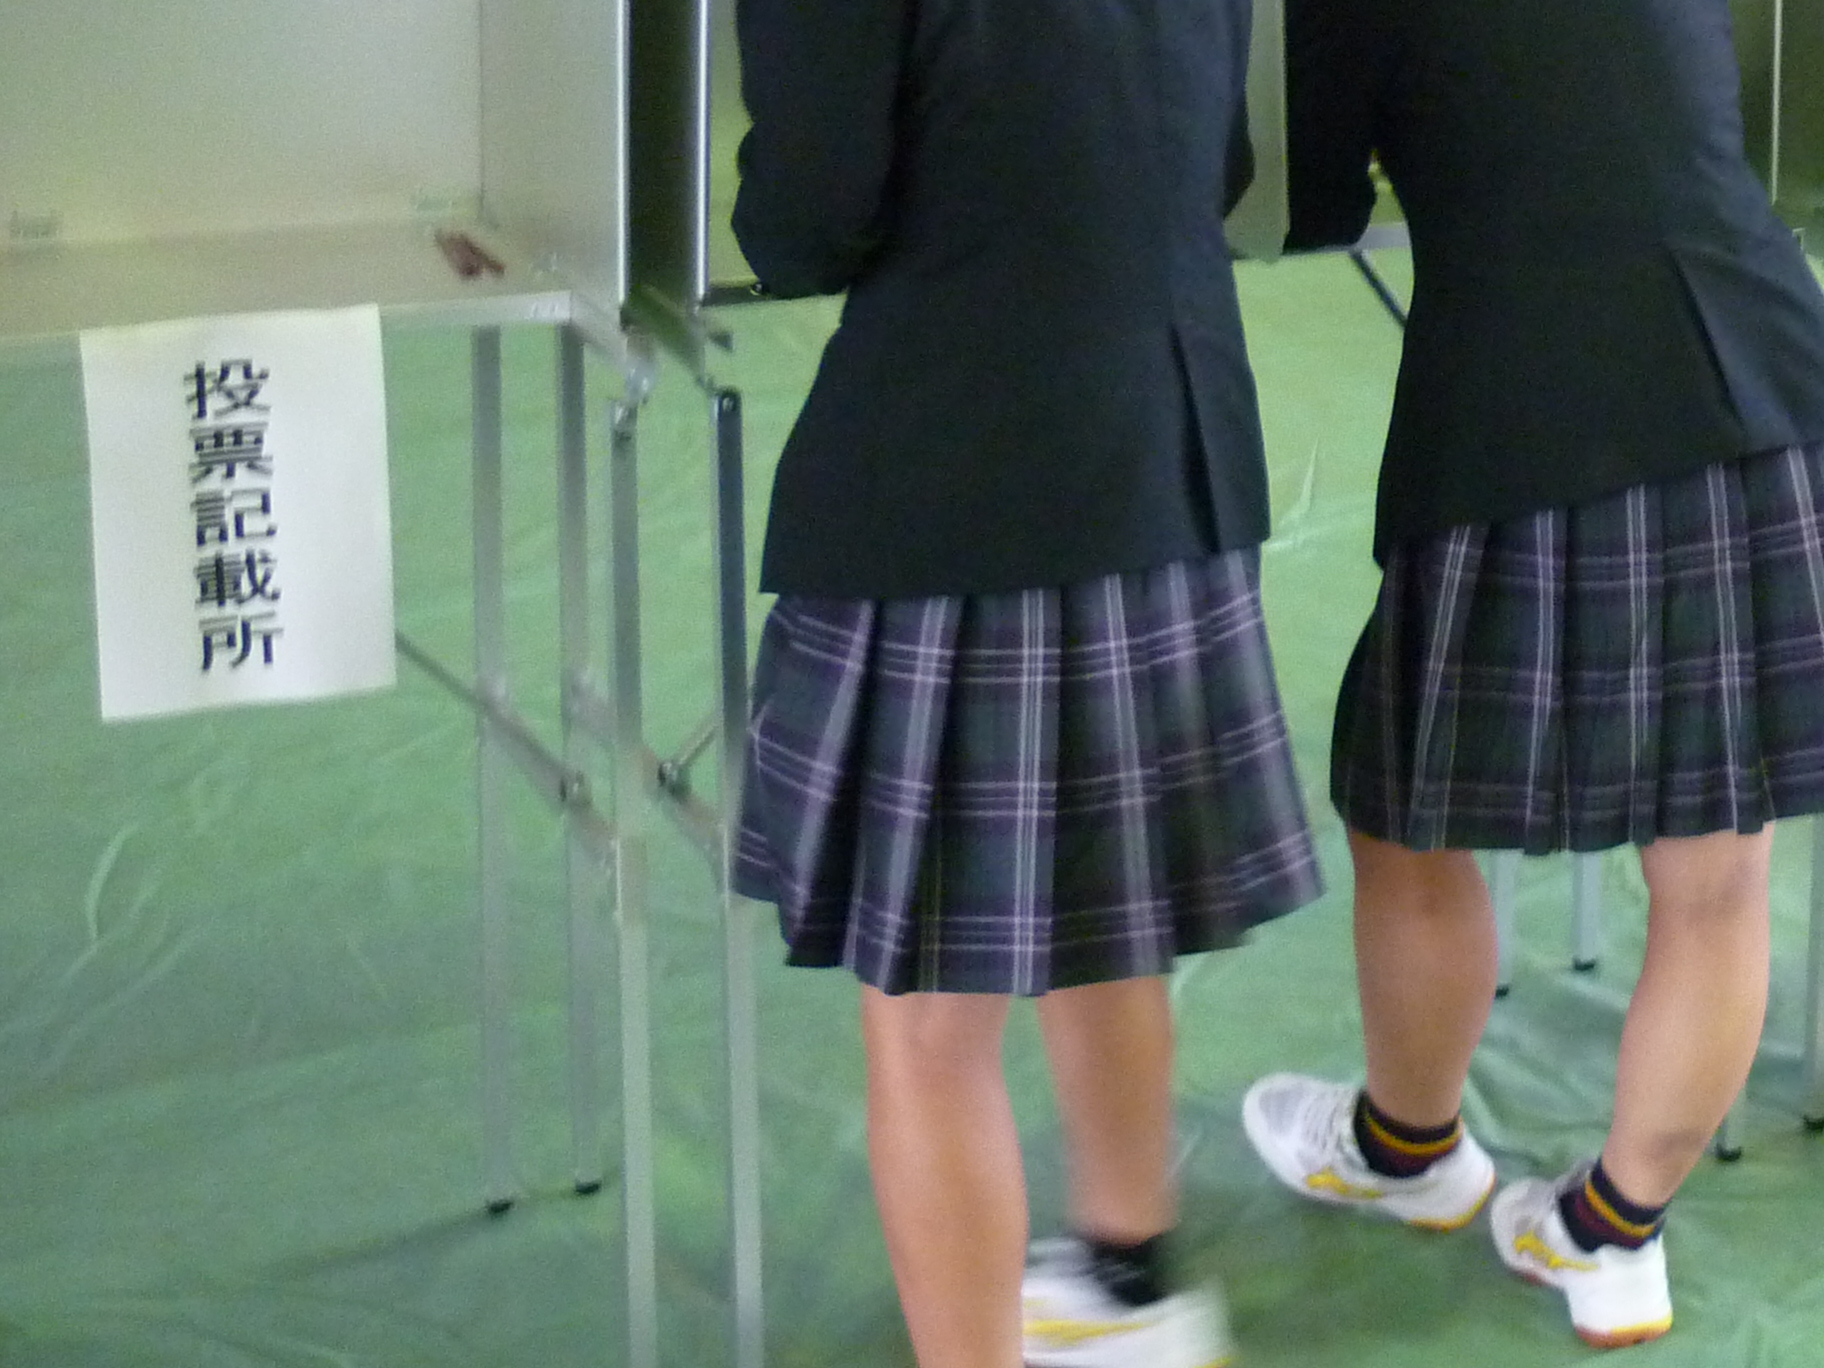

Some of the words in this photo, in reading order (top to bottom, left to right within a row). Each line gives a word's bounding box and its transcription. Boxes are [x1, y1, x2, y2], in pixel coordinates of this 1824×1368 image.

[183, 358, 284, 674] 投票記載所
